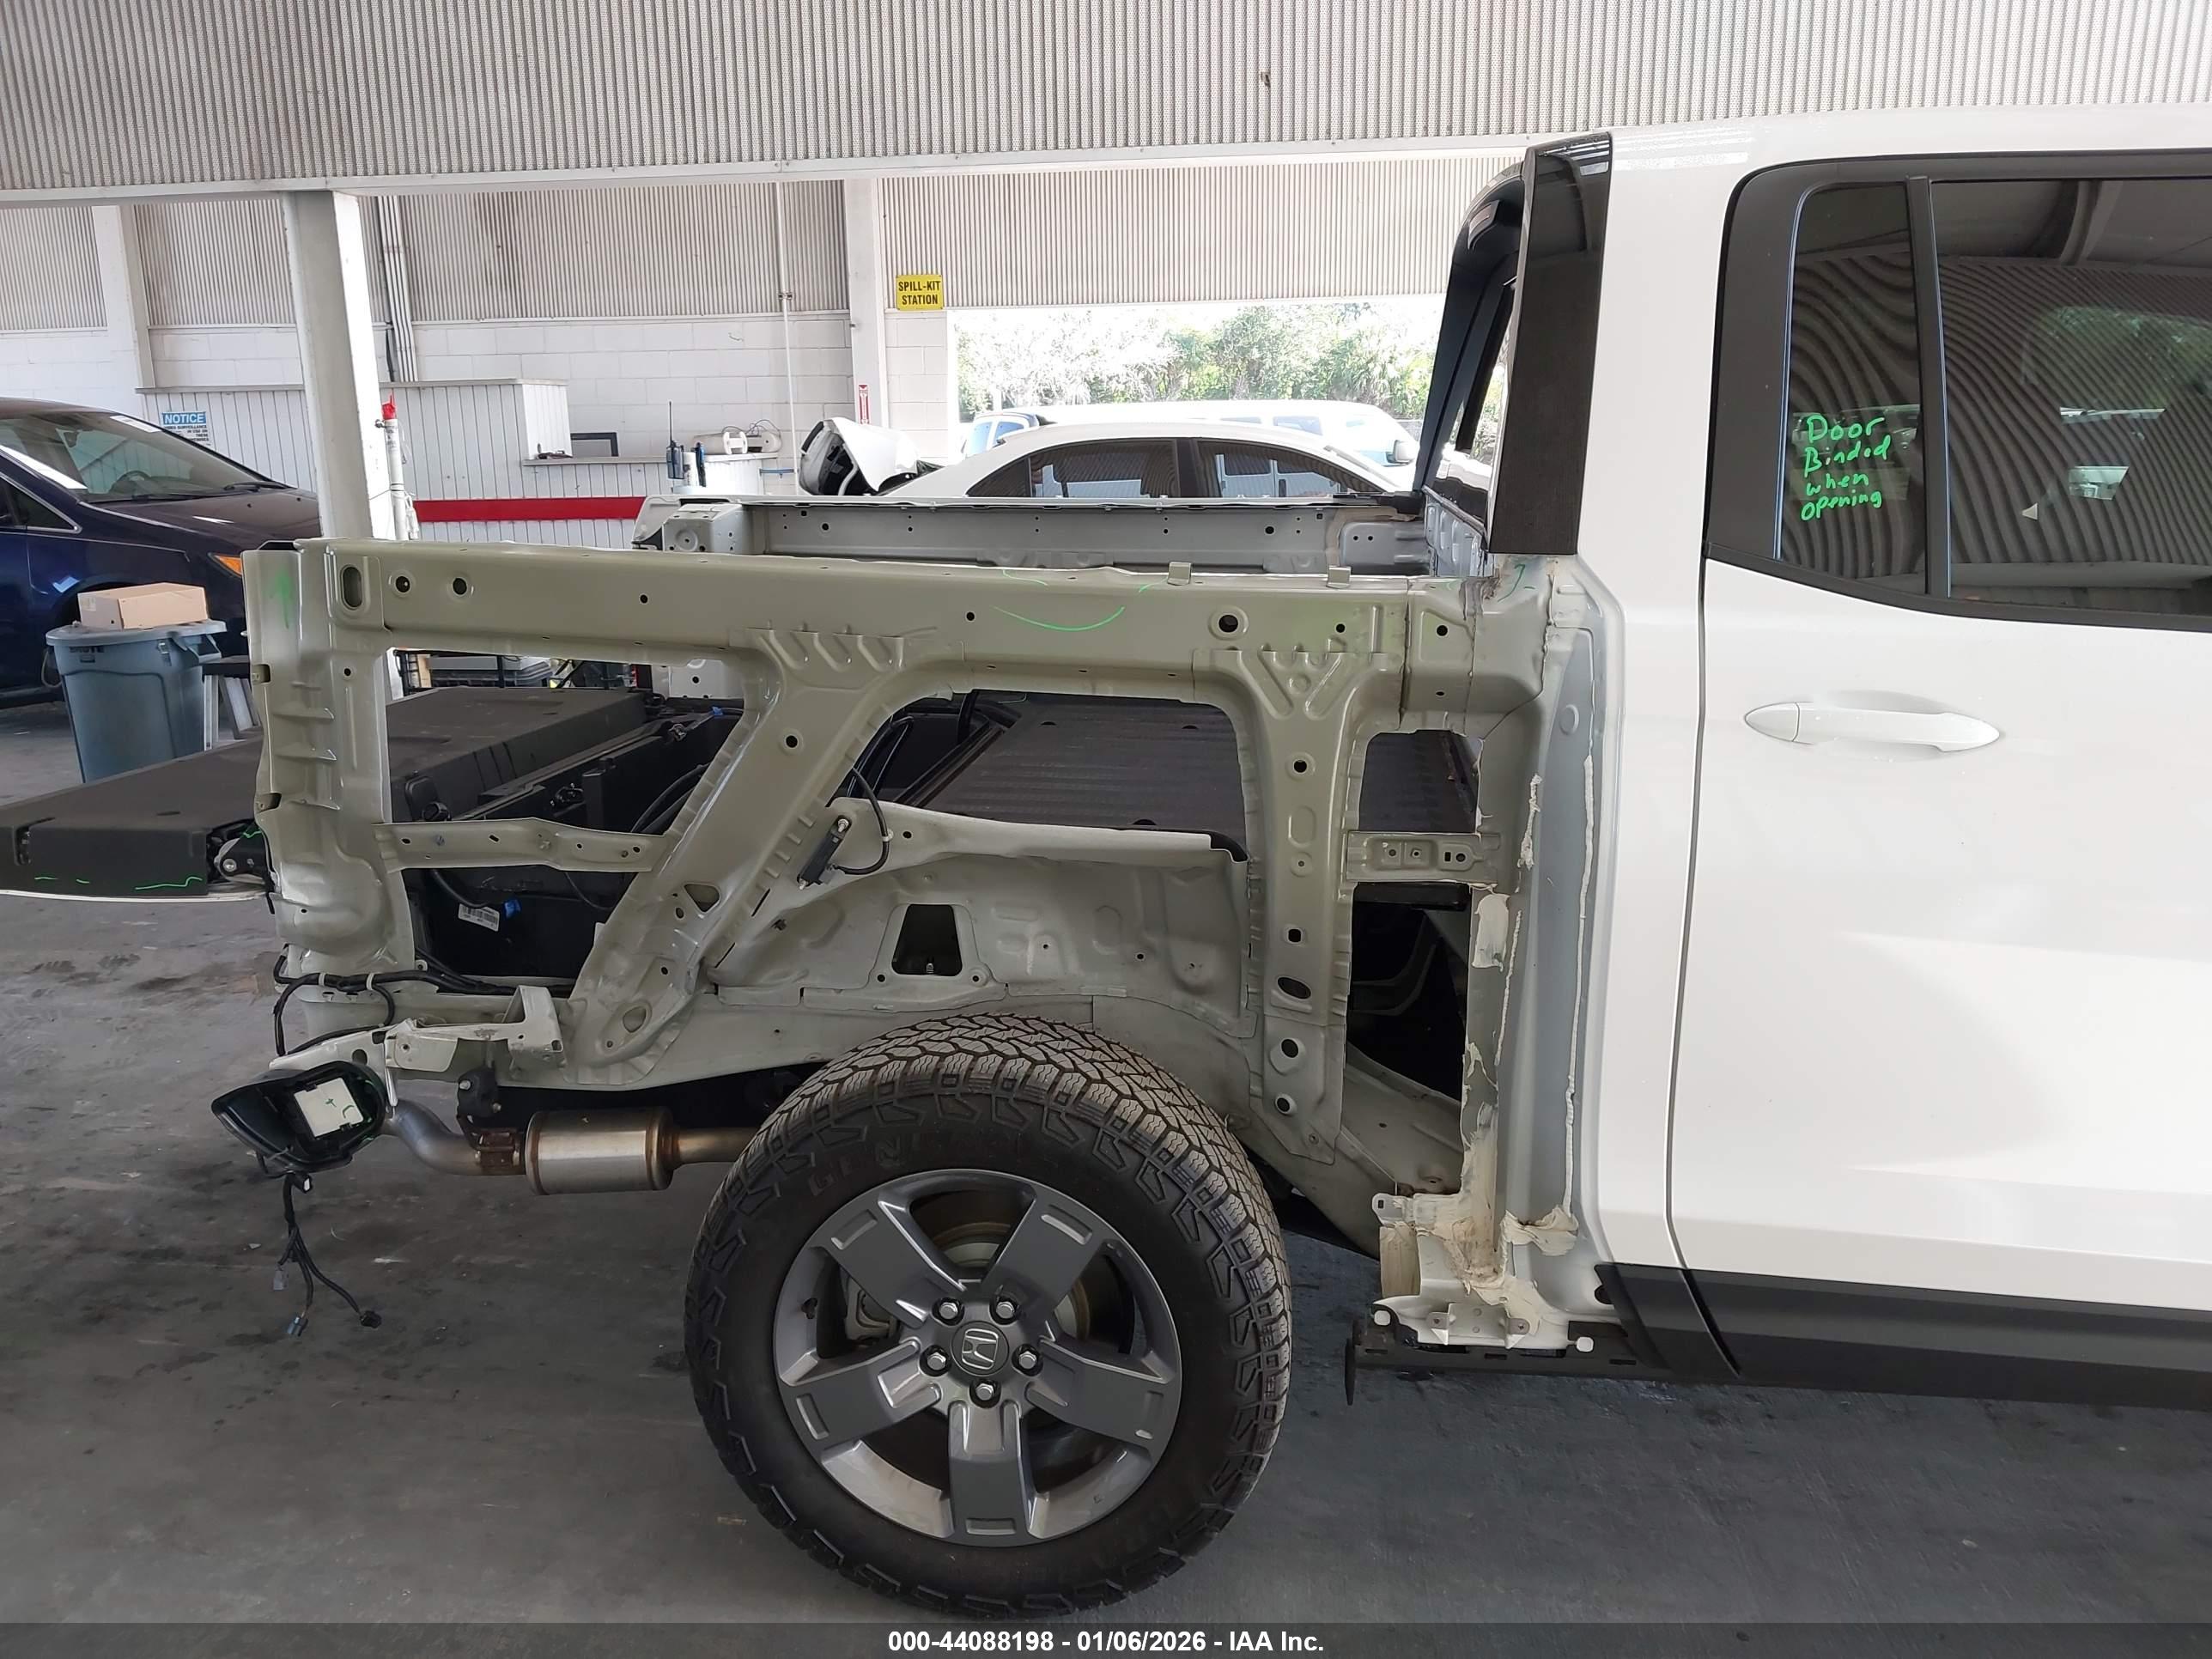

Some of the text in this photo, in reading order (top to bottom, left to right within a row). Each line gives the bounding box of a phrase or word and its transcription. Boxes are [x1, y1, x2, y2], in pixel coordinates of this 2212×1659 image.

[898, 281, 941, 291] SPILL-KIT
[902, 295, 938, 305] STATION
[164, 414, 204, 424] NOTICE
[1806, 414, 1885, 443] Door
[1806, 473, 1869, 496] when
